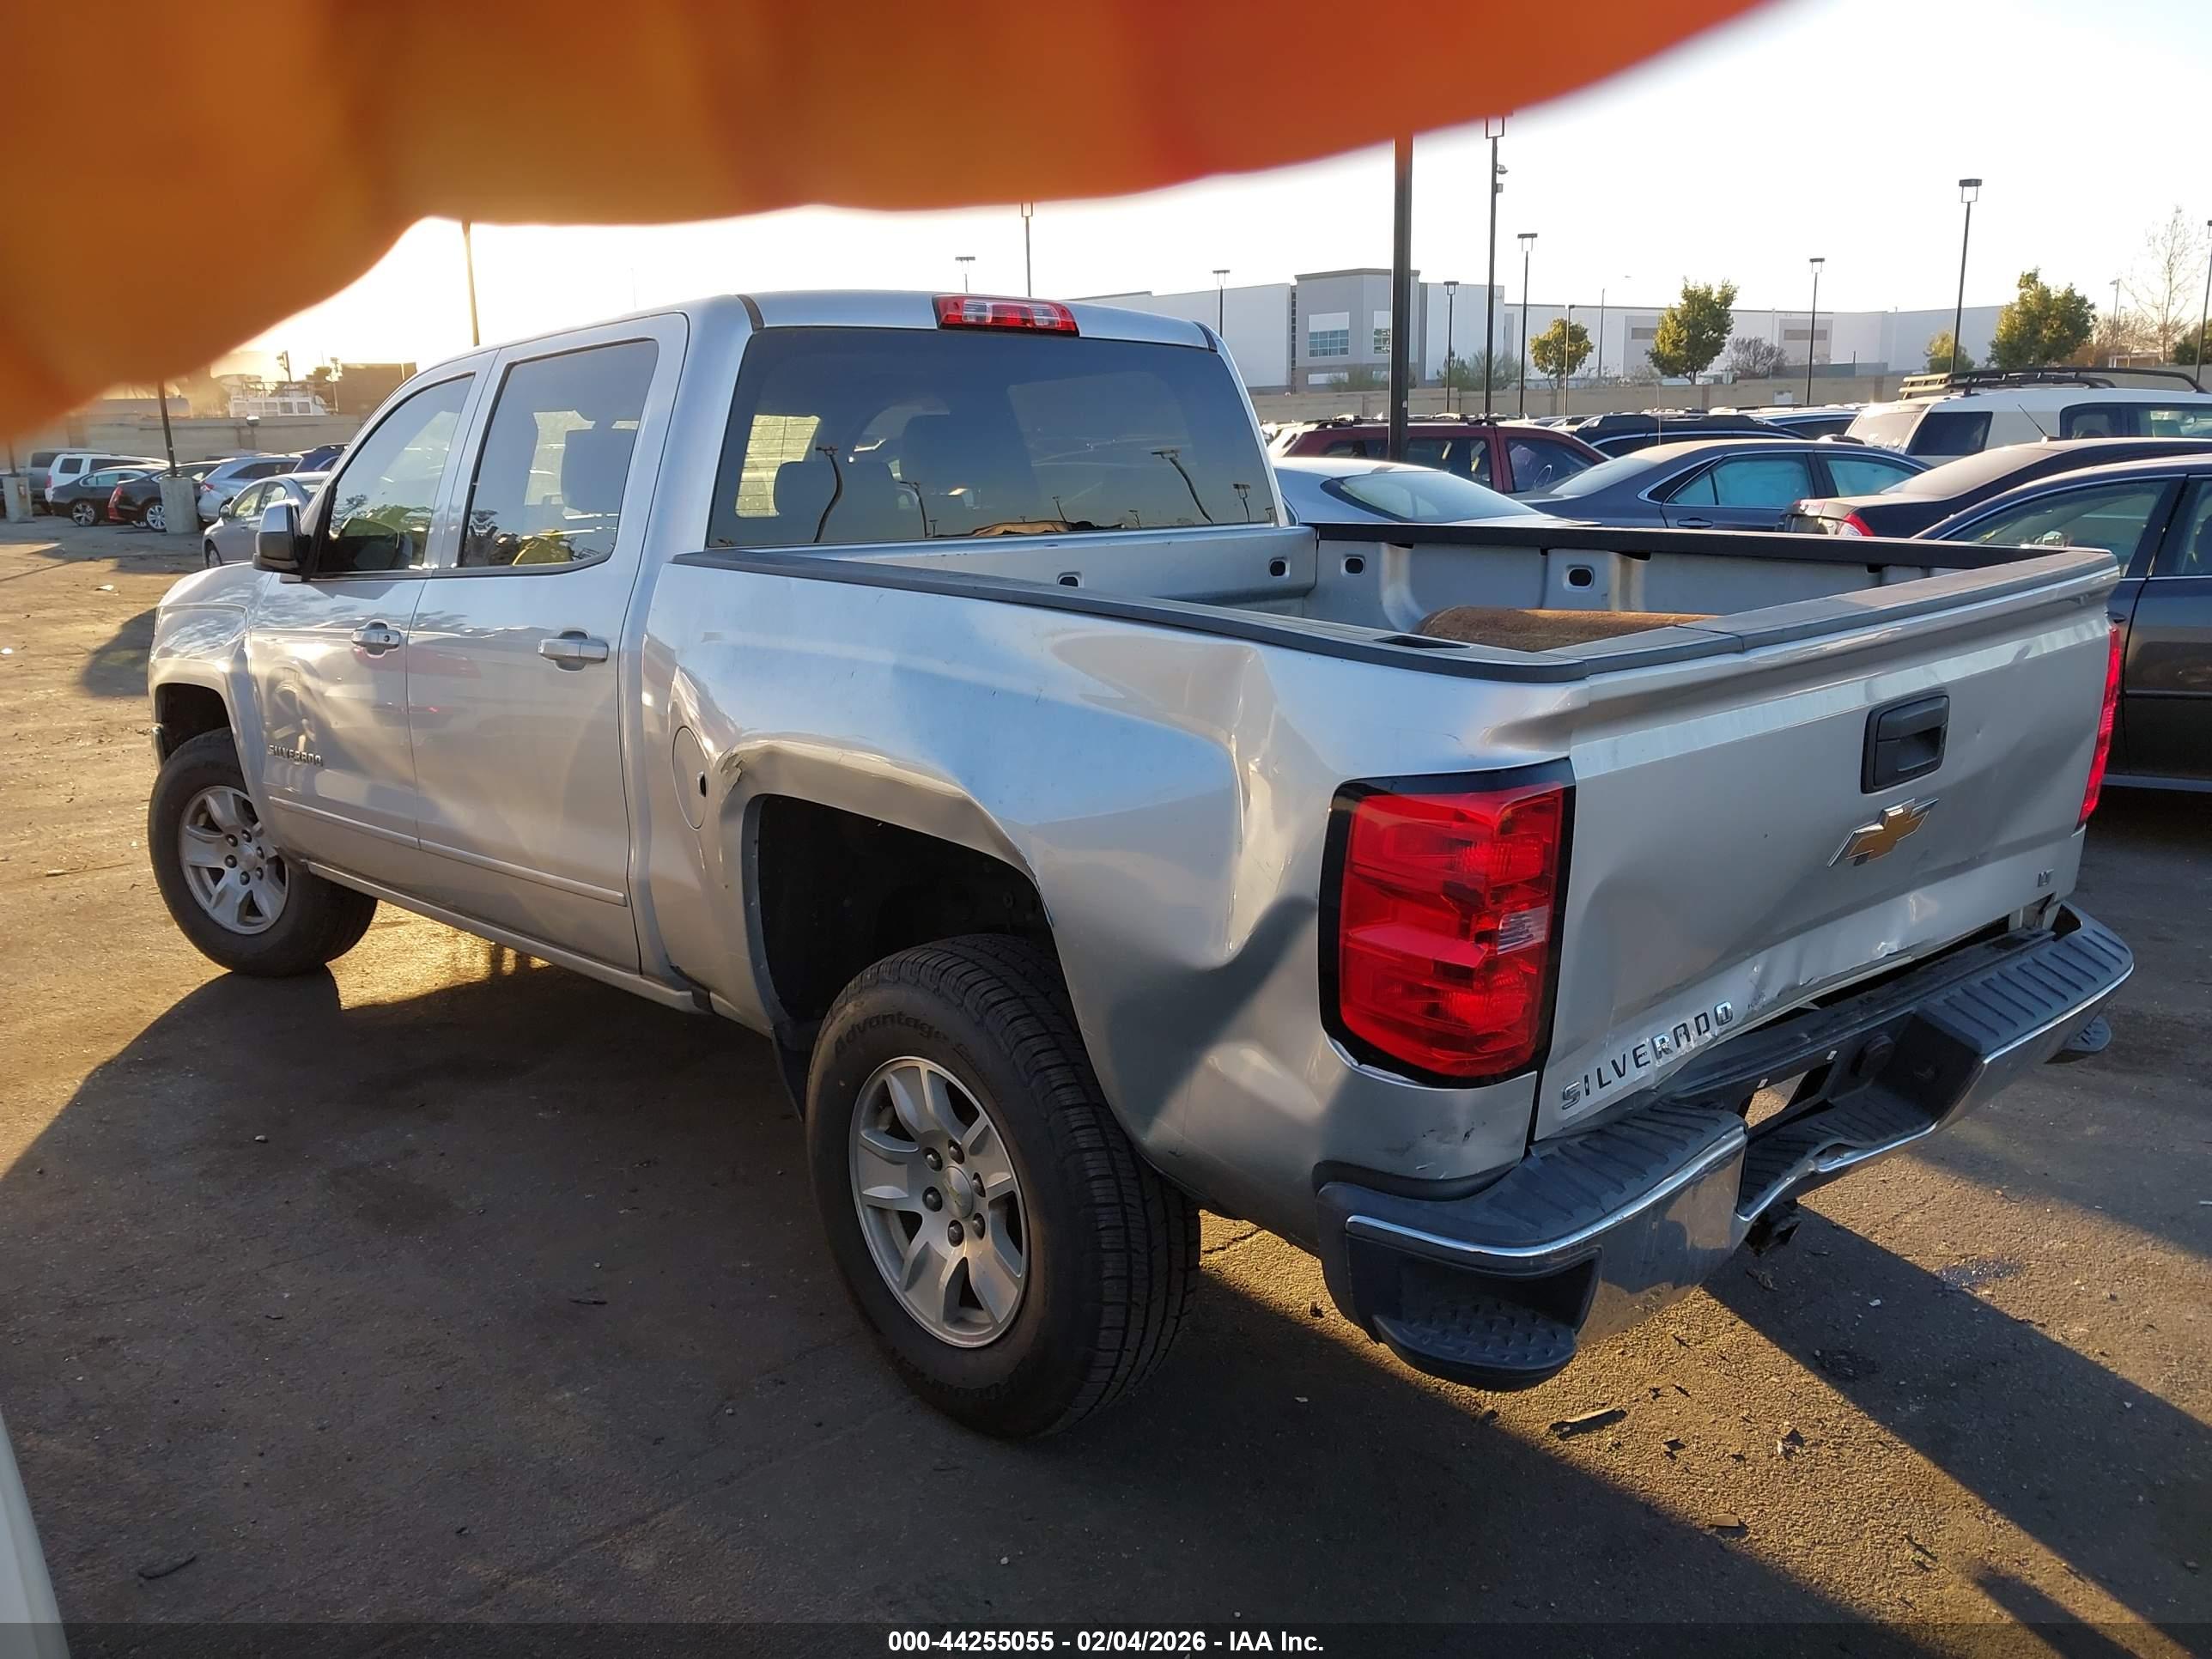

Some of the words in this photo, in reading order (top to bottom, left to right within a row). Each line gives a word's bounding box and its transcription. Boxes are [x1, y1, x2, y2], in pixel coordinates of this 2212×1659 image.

[268, 744, 324, 767] SILVERADO
[835, 1010, 950, 1058] Advantage
[1561, 1000, 1734, 1110] SILVERADO
